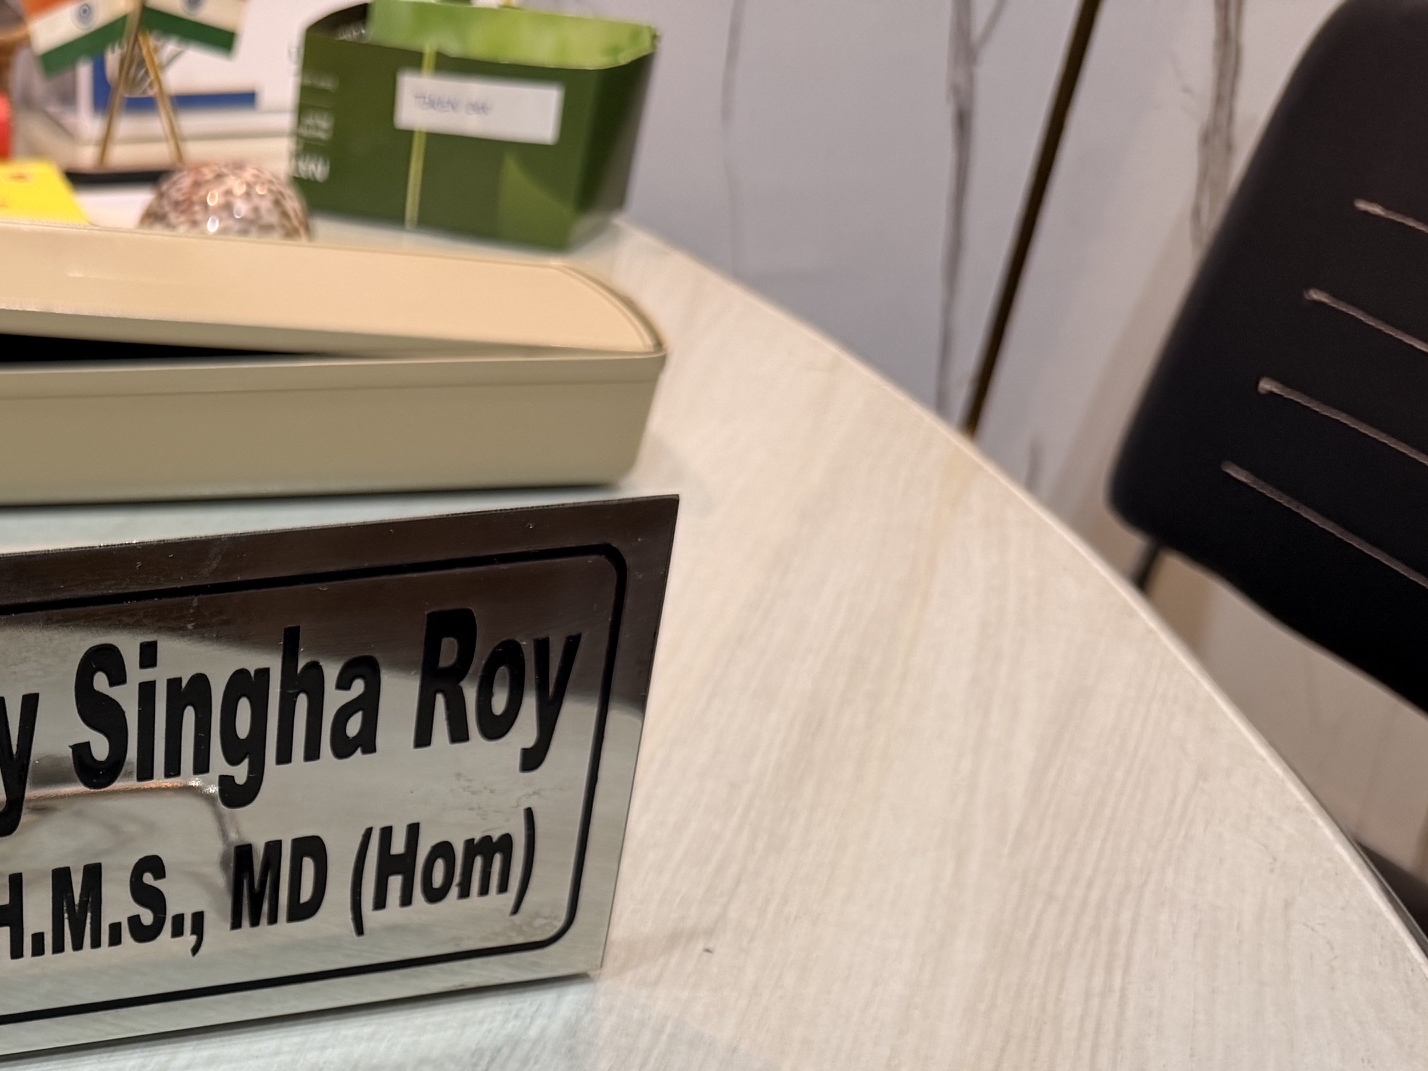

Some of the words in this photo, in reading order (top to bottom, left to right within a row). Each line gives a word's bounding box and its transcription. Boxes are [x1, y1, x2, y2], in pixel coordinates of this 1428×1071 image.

[68, 625, 381, 809] Singha
[413, 607, 582, 773] Roy
[230, 834, 328, 931] MD
[350, 806, 536, 936] (Hom)
